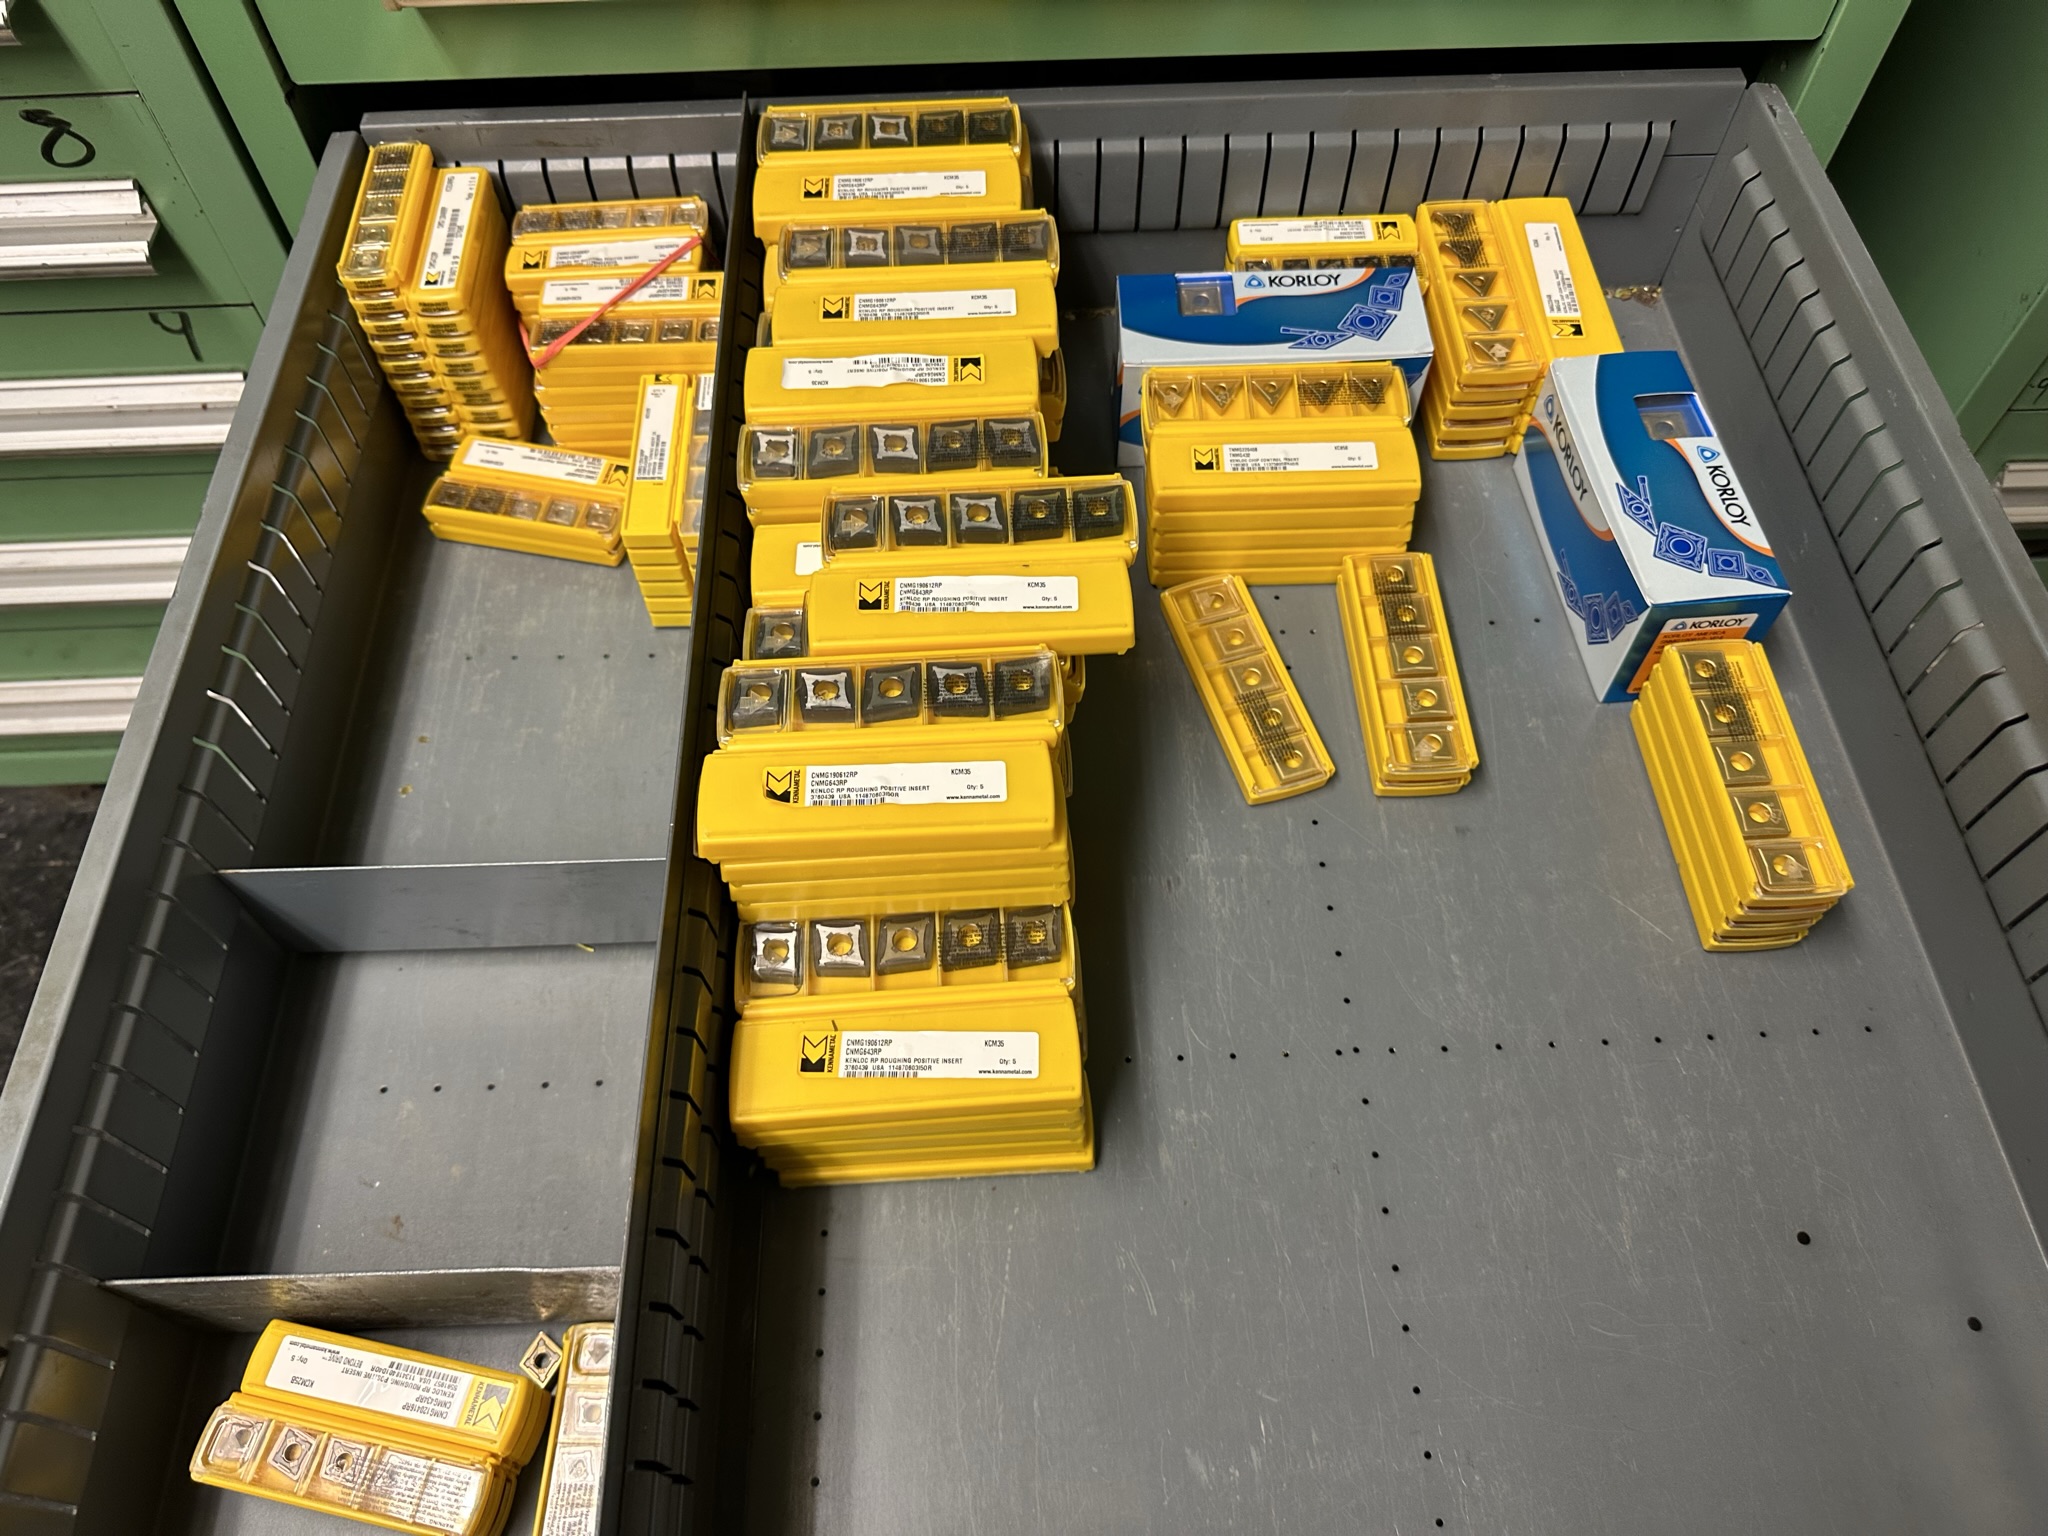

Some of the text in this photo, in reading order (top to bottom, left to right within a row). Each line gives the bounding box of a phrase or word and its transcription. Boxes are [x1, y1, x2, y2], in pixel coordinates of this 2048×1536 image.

[19, 109, 95, 168] 8
[1268, 274, 1341, 287] KORLOY
[1552, 415, 1588, 501] KORLOY
[1706, 465, 1750, 526] KORLOY
[1689, 618, 1748, 630] KORLOY
[811, 771, 858, 779] CNMG190612RP
[811, 779, 847, 787] CNMG643RP
[827, 1034, 836, 1073] KENNAMETAL
[342, 1368, 363, 1377] INSERT
[432, 1388, 455, 1398] KENLOC
